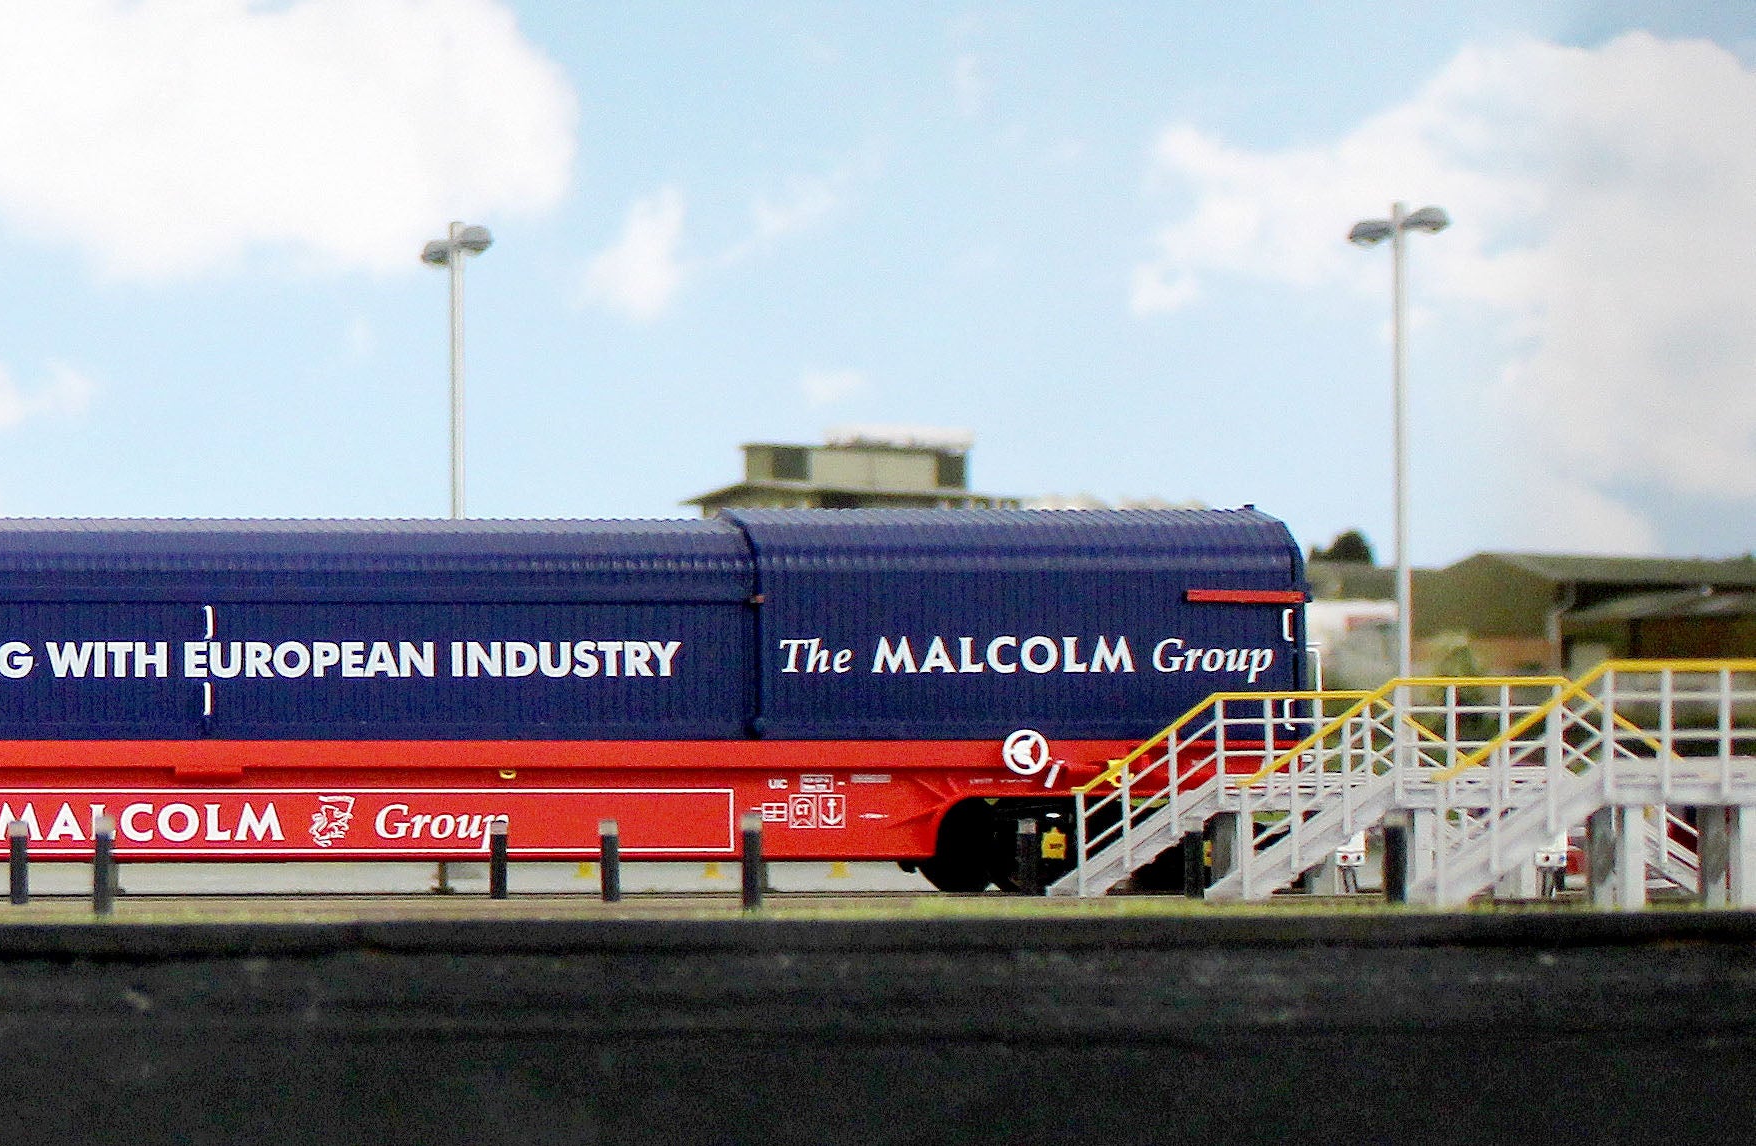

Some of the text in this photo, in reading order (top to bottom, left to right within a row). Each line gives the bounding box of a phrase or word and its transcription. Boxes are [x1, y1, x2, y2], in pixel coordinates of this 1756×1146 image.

[46, 641, 169, 679] WITH
[184, 641, 436, 679] EUROPEAN
[451, 641, 683, 679] INDUSTRY
[780, 636, 1275, 684] The MALCOLM Group
[375, 803, 509, 850] Group
